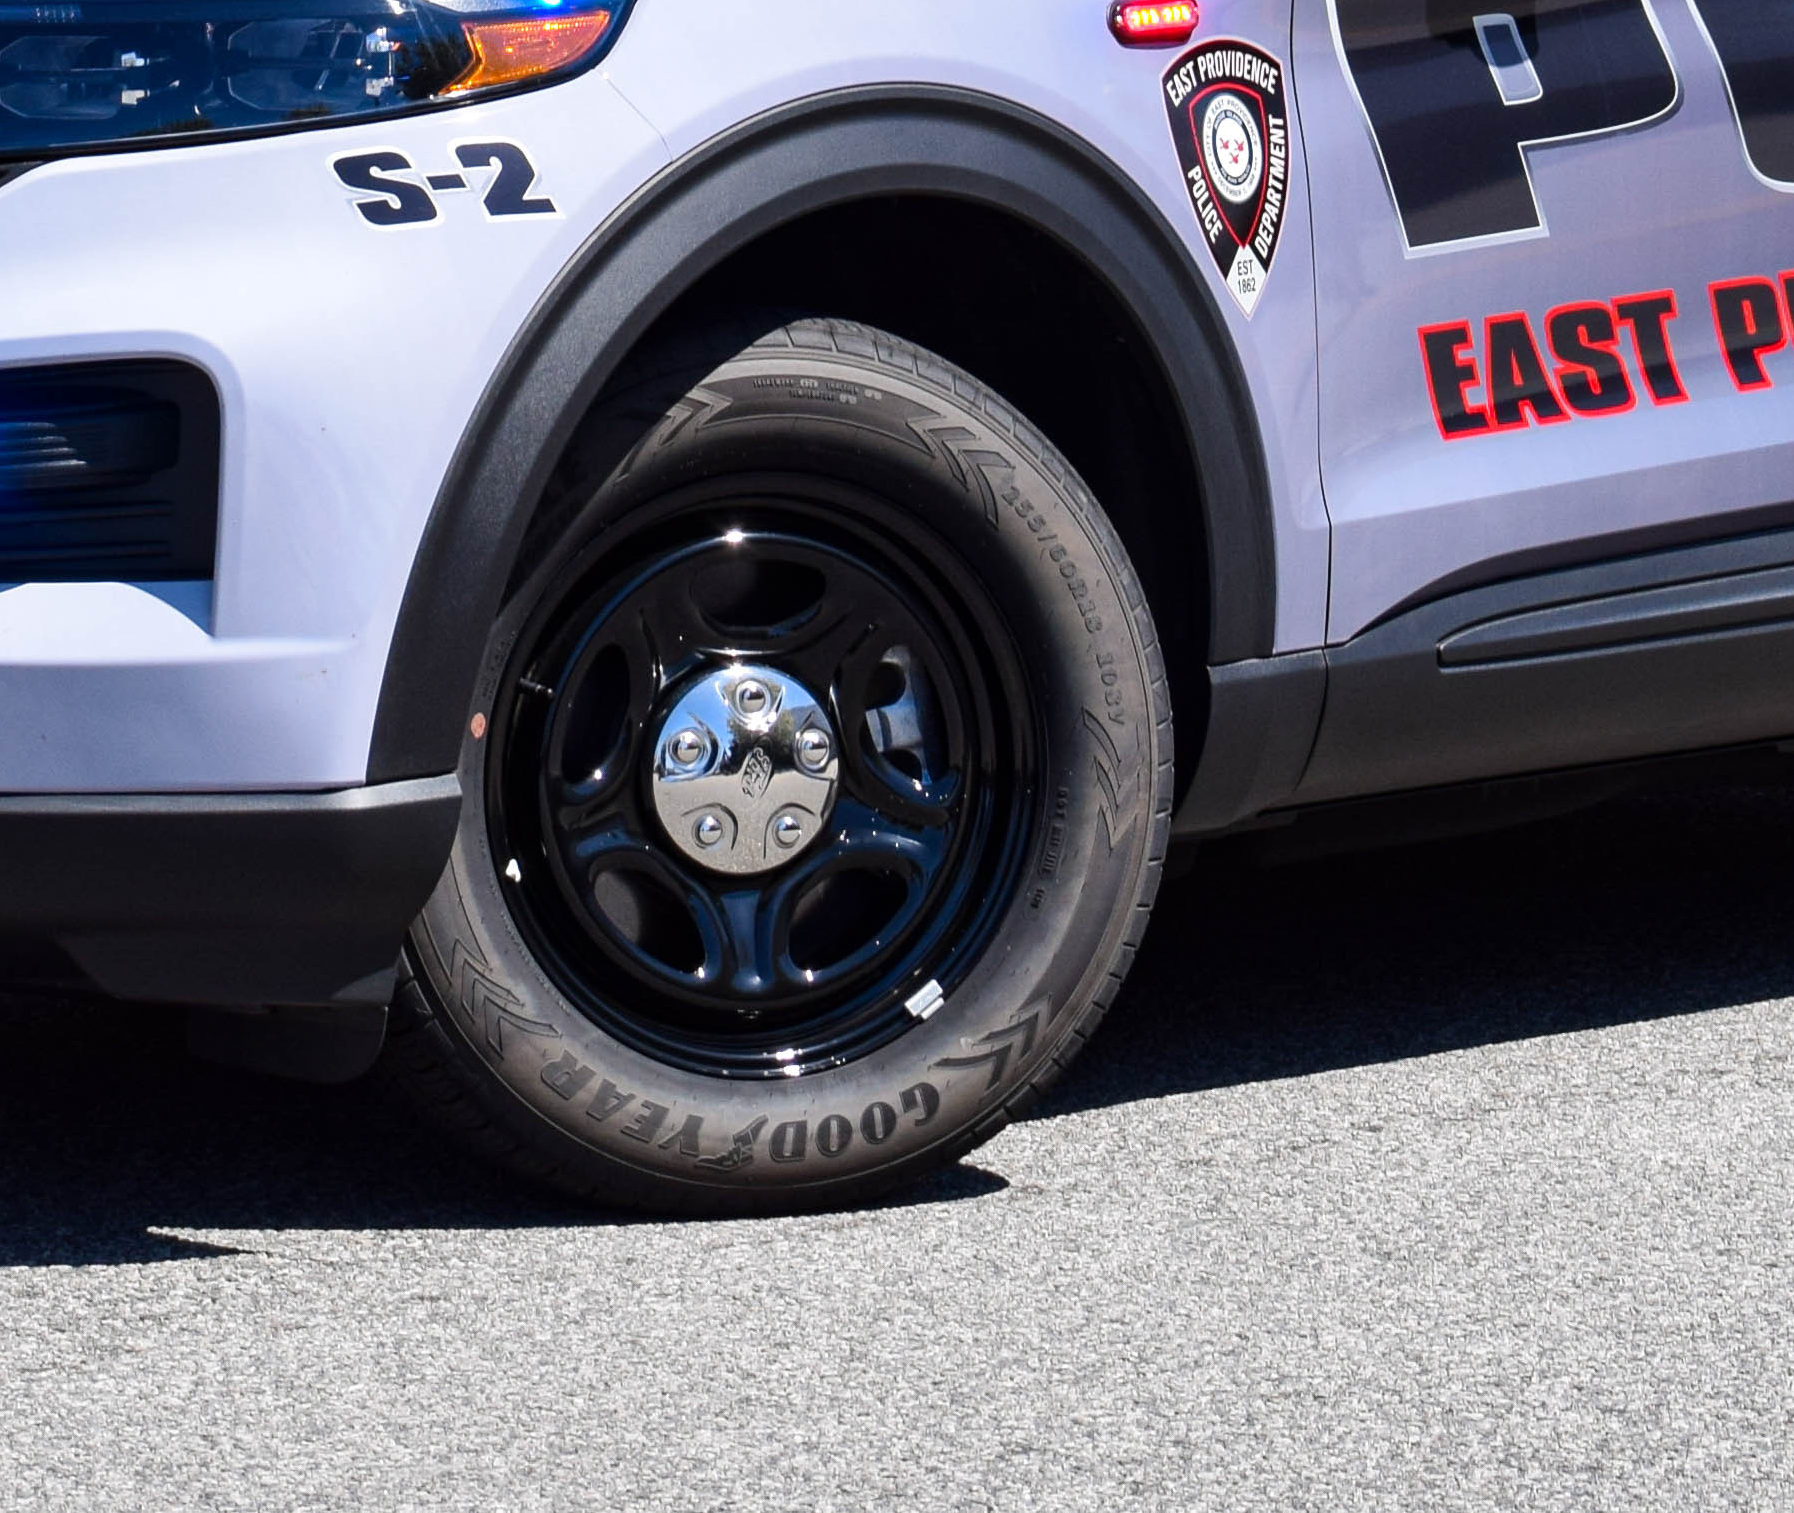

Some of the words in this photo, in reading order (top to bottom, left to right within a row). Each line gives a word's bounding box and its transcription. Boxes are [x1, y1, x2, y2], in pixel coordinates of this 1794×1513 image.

[1166, 62, 1198, 108] EAST
[1197, 50, 1278, 94] PROVIDENCE
[333, 141, 557, 226] S-2
[1187, 165, 1224, 244] POLICE
[1254, 114, 1286, 259] DEPARTMENT
[1237, 259, 1254, 276] EST
[1237, 278, 1257, 294] 1862
[1417, 288, 1689, 442] EAST
